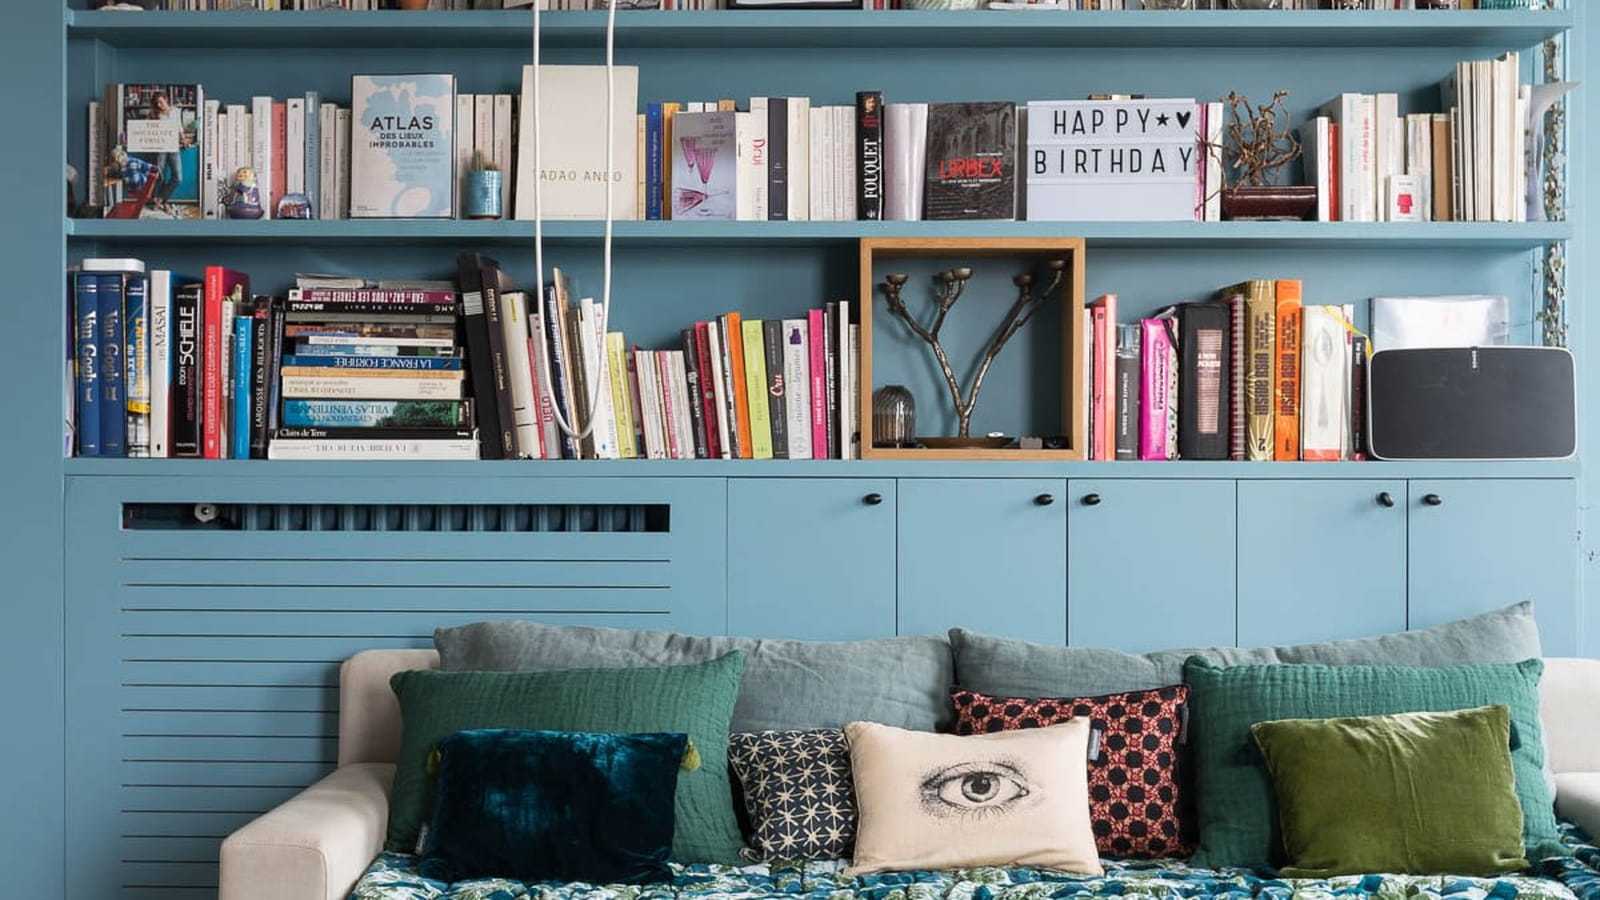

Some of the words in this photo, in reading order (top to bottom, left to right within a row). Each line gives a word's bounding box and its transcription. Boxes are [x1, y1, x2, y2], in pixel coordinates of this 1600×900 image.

[370, 116, 433, 131] ATLAS
[1054, 108, 1150, 134] HAPPY
[369, 141, 434, 149] IMPROBABLES
[863, 138, 880, 199] FOUQUET
[940, 157, 1003, 179] URBEX
[1035, 147, 1192, 174] BIRTHDAY
[537, 170, 577, 182] ADAO
[82, 311, 96, 339] Van
[104, 311, 118, 339] Van
[180, 306, 195, 366] SCHIELE
[81, 344, 97, 383] Gogh
[103, 344, 119, 383] Gogh
[256, 367, 264, 383] DES
[380, 358, 419, 369] FRANCE
[419, 359, 432, 368] LA
[770, 373, 784, 397] Cru
[255, 386, 264, 428] LAROUSSE
